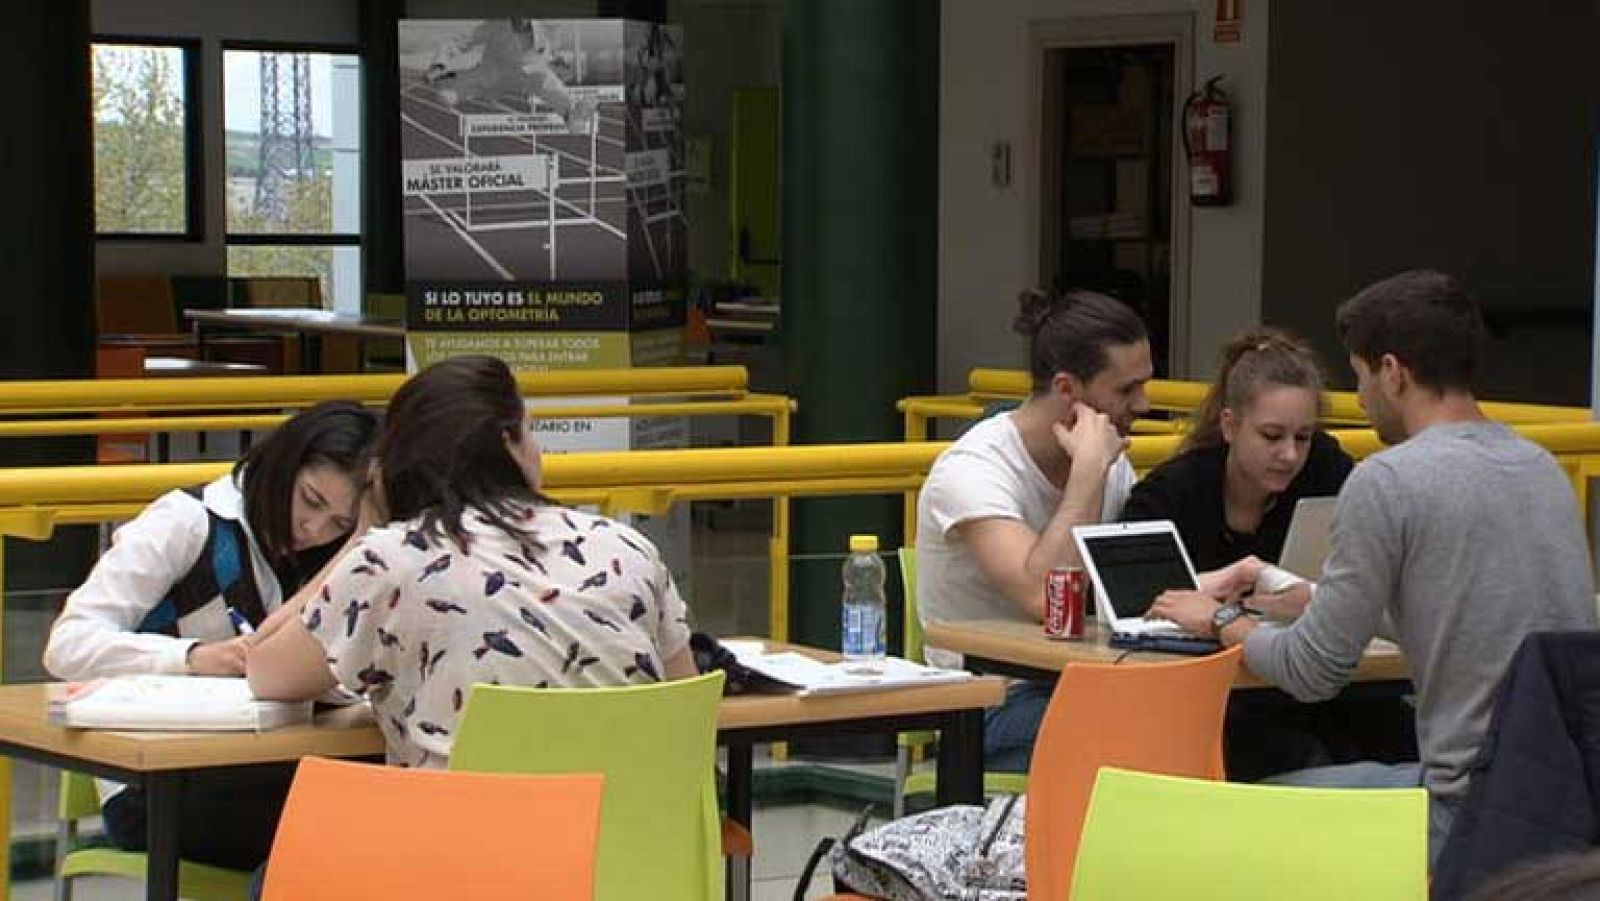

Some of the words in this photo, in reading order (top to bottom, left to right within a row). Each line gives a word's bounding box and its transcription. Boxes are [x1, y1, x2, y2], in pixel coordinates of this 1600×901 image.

[407, 173, 463, 191] MÁSTER
[468, 173, 525, 189] OFICIAL
[424, 291, 438, 306] SI
[442, 291, 461, 306] LO
[465, 291, 504, 306] TUYO
[507, 291, 524, 306] ES
[527, 291, 543, 306] EL
[546, 291, 603, 306] MUNDO
[424, 307, 442, 321] DE
[447, 307, 465, 321] LA
[469, 305, 560, 321] OPTOMETRÍA
